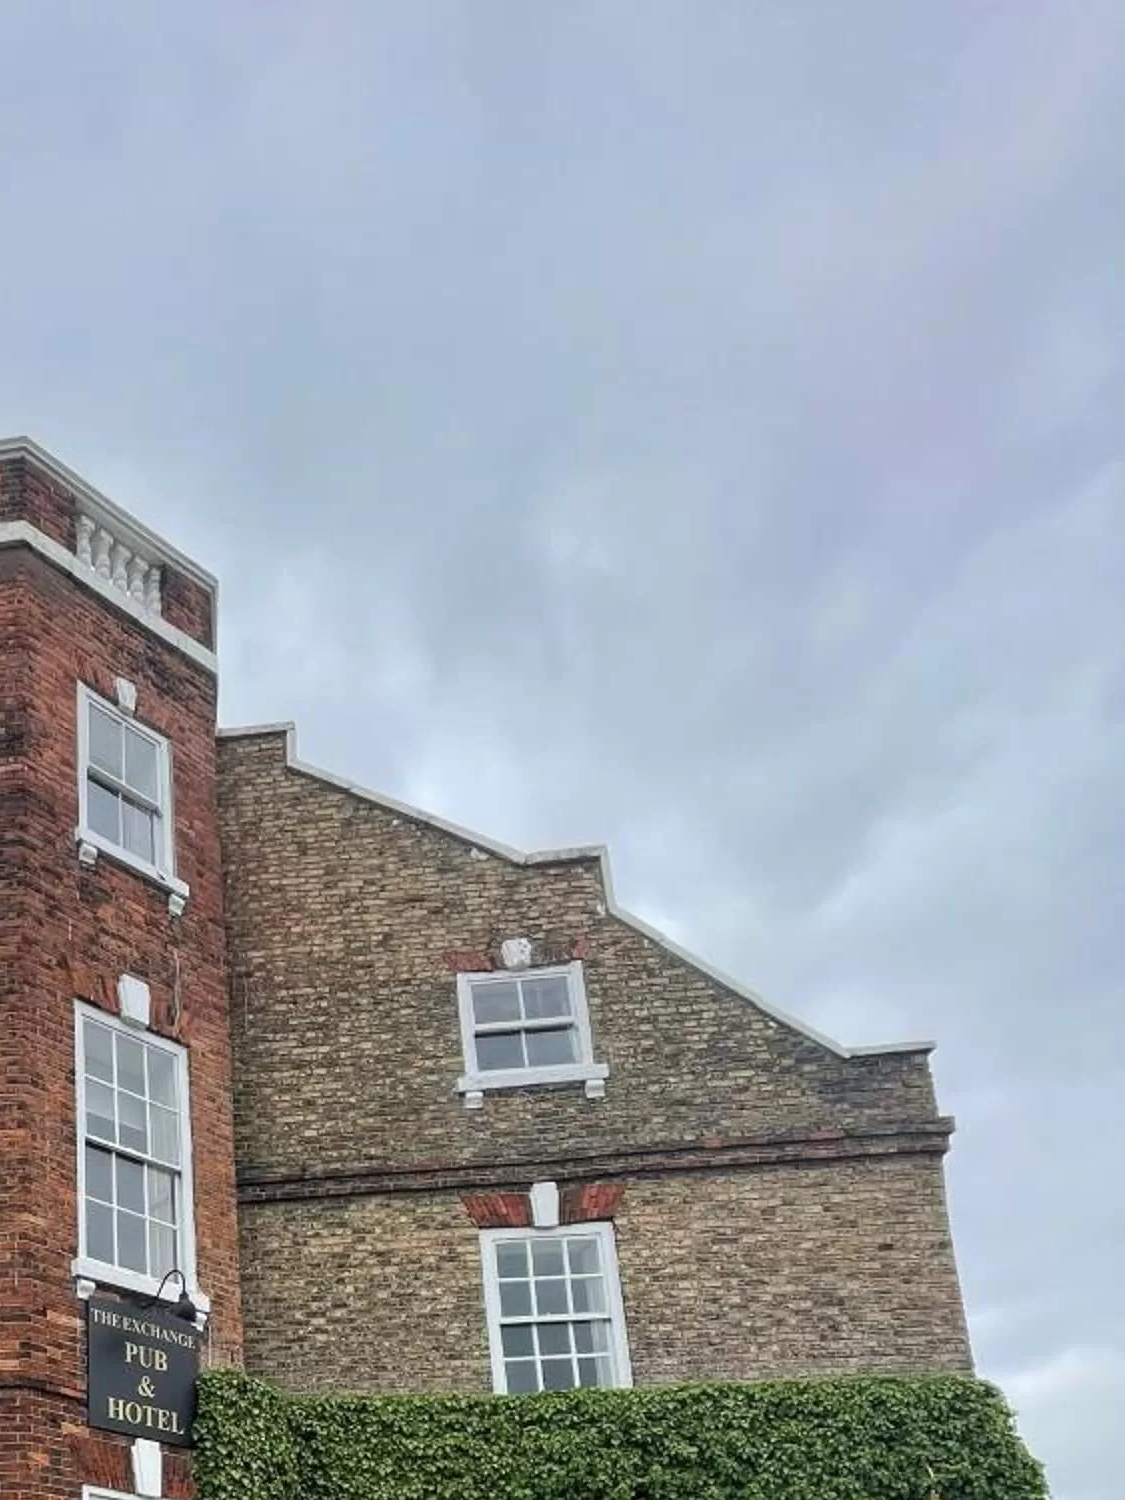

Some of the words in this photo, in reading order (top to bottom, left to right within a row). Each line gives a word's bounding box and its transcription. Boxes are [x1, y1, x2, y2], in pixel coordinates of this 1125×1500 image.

[91, 1308, 122, 1329] THE
[122, 1316, 196, 1349] EXCHANGE
[125, 1341, 168, 1371] PUB
[137, 1375, 156, 1398] &
[107, 1397, 184, 1435] HOTEL
